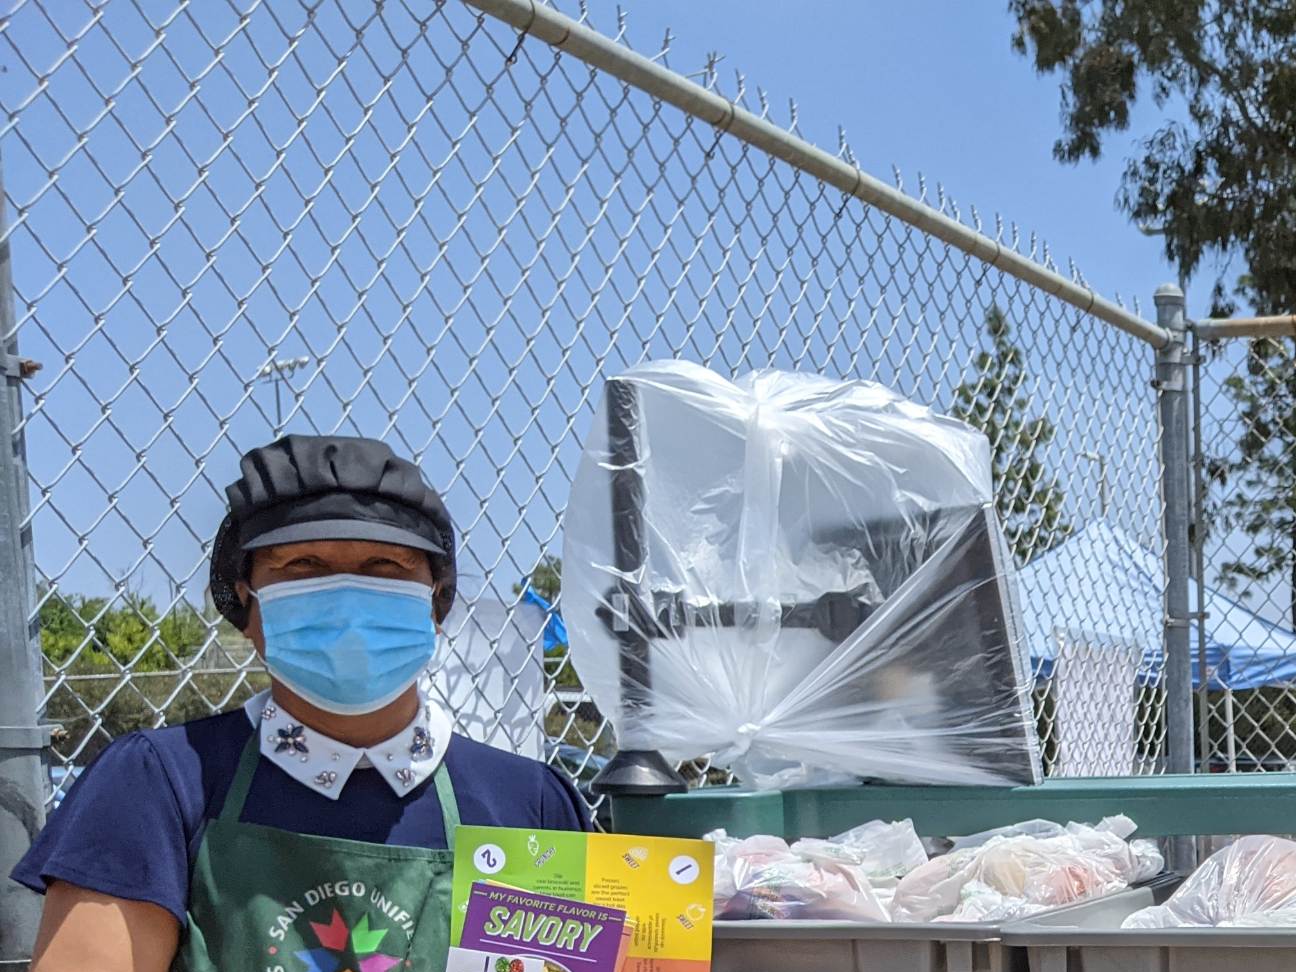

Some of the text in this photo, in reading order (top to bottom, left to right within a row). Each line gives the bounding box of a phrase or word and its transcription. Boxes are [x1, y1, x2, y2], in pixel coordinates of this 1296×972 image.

[481, 849, 497, 868] 2
[621, 853, 640, 869] SWEET
[269, 881, 414, 941] SAN DIEGO UNIFIE
[489, 891, 505, 900] MY
[508, 894, 556, 911] FAVORITE
[557, 904, 597, 919] FLAVOR
[598, 913, 609, 921] IS
[484, 906, 603, 952] SAVORY
